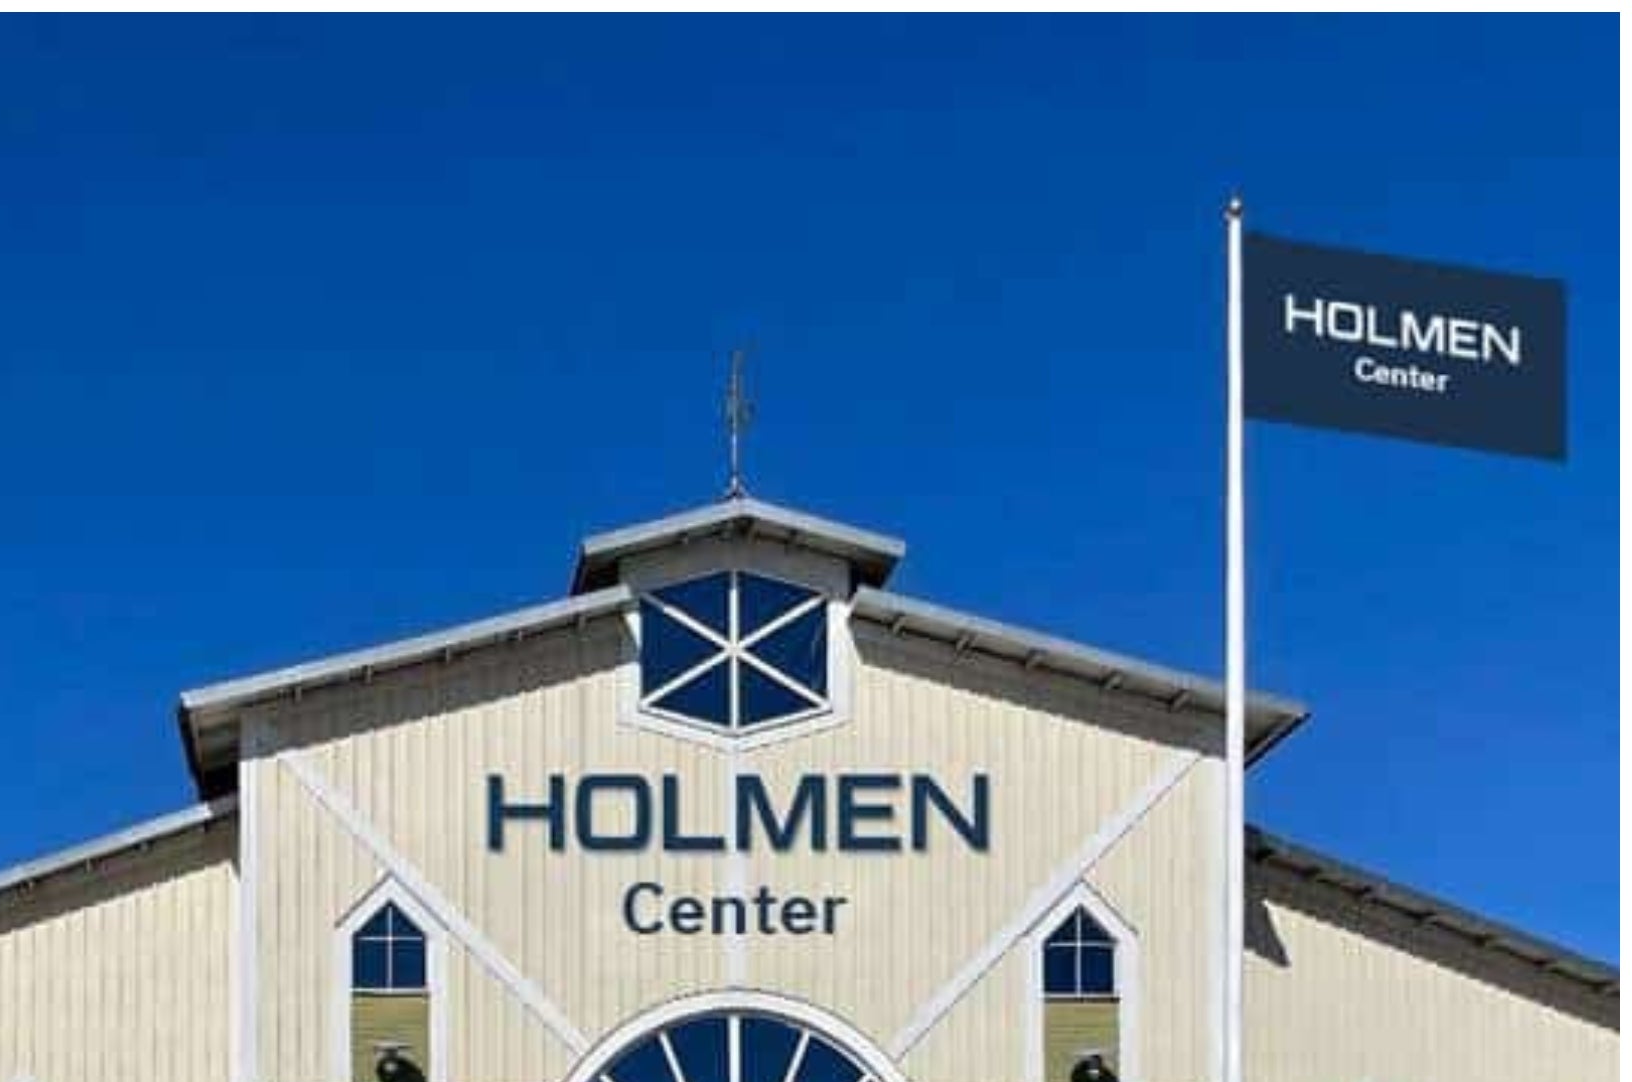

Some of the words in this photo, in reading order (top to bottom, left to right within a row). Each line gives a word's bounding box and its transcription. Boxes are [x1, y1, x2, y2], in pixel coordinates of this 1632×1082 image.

[1283, 293, 1522, 367] HOLMEN
[1353, 356, 1449, 393] Center
[485, 773, 992, 852] HOLMEN
[622, 882, 848, 936] Center
